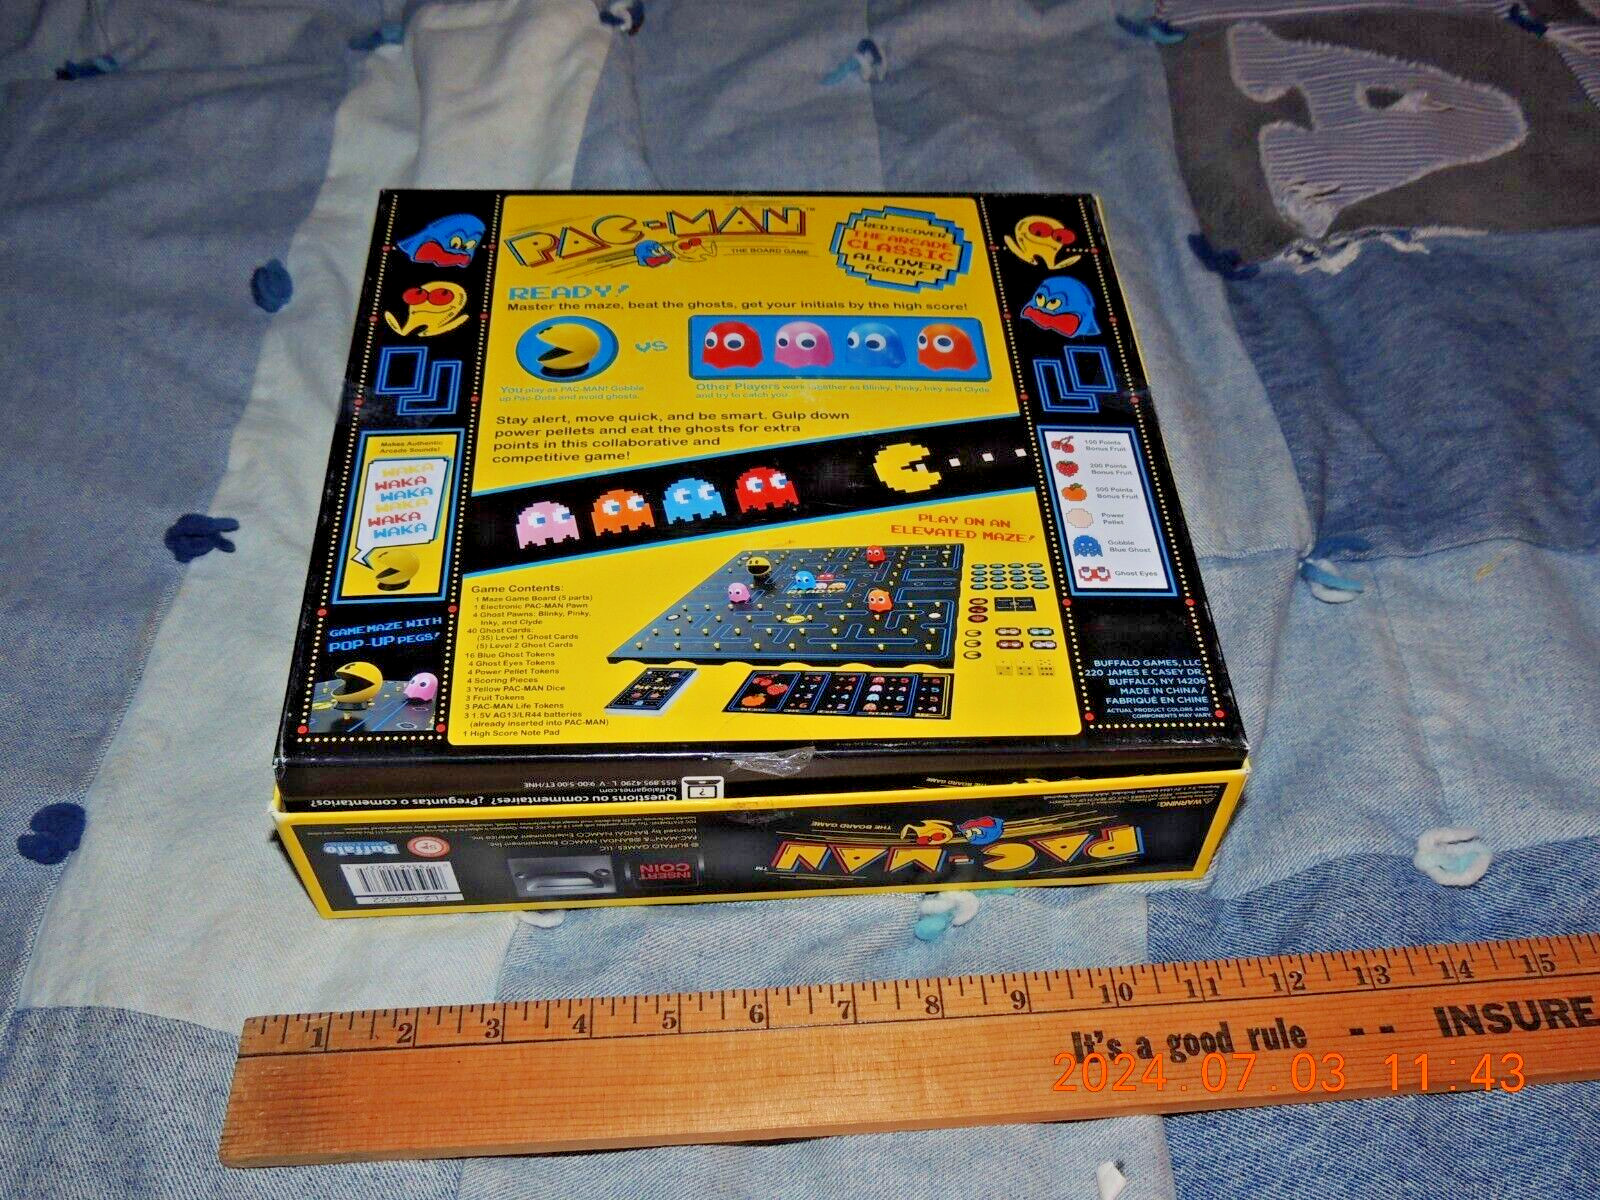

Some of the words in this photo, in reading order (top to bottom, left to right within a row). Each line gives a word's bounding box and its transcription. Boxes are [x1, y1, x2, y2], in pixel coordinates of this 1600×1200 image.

[863, 221, 947, 239] REDISCOVER
[504, 206, 806, 268] PAC-MAN
[851, 230, 885, 244] THE
[888, 235, 951, 250] ARCADE
[731, 247, 748, 255] THE
[783, 248, 810, 256] GAME
[847, 239, 953, 262] CLASSIC
[852, 252, 890, 265] ALL
[894, 257, 943, 272] OVER
[508, 285, 630, 300] READY!
[507, 302, 556, 312] Master
[559, 302, 580, 310] the
[584, 302, 624, 311] maze,
[628, 301, 658, 309] beat
[663, 301, 684, 309] the
[688, 301, 738, 311] ghosts,
[741, 301, 763, 310] get
[767, 301, 796, 310] your
[800, 301, 845, 309] initials
[849, 301, 865, 310] by
[868, 301, 889, 309] the
[893, 301, 922, 311] high
[926, 302, 968, 311] score!
[695, 383, 732, 391] Other
[735, 383, 781, 392] Players
[496, 415, 528, 426] Stay
[533, 414, 570, 424] alert,
[619, 413, 663, 423] quick,
[667, 412, 695, 421] and
[699, 412, 717, 420] be
[721, 411, 767, 420] smart.
[772, 410, 806, 421] Gulp
[811, 411, 850, 420] down
[494, 428, 541, 439] power
[546, 427, 595, 437] pellets
[599, 426, 627, 435] and
[631, 426, 654, 434] eat
[658, 425, 681, 434] the
[685, 424, 735, 436] ghosts
[739, 424, 758, 433] for
[763, 424, 801, 433] extra
[493, 440, 539, 452] points
[544, 440, 557, 449] in
[561, 439, 588, 448] this
[592, 437, 688, 447] collaborative
[693, 437, 720, 446] and
[493, 453, 580, 464] competitive
[584, 451, 631, 462] game!
[375, 475, 427, 491] WAKA
[380, 487, 433, 502] WAKA
[368, 511, 421, 527] WAKA
[918, 514, 958, 524] PLAY
[964, 517, 984, 526] ON
[990, 519, 1010, 528] AN
[374, 523, 427, 539] WAKA
[891, 525, 977, 539] ELEVATED
[982, 532, 1035, 543] MAZE!
[471, 585, 505, 593] Game
[509, 584, 563, 593] Contents:
[329, 625, 366, 637] GAME
[366, 621, 403, 632] MAZE
[406, 617, 442, 627] WITH
[329, 636, 395, 652] POP-UP
[398, 632, 441, 644] PEGS!
[1094, 659, 1140, 667] BUFFALO
[1143, 659, 1181, 667] GAMES,
[1085, 669, 1104, 677] 220
[1108, 678, 1158, 686] BUFFALO,
[1120, 687, 1150, 695] MADE
[472, 702, 513, 710] PAC-MAN
[1160, 696, 1174, 704] EN
[1177, 696, 1209, 704] CHINE
[493, 711, 542, 719] AG13/LR44
[470, 730, 490, 738] High
[599, 786, 677, 794] buffalogames.com
[311, 798, 397, 807] comentarios?
[491, 795, 589, 805] commentaires?
[612, 793, 677, 802] Questions
[1157, 798, 1202, 807] WARNING:
[323, 843, 394, 856] Buffalo
[770, 825, 1144, 873] PAC-MAN
[639, 863, 690, 872] COIN
[639, 871, 691, 881] INSERT
[311, 1027, 325, 1048] 1
[397, 1022, 413, 1044] 2
[485, 1018, 501, 1040] 3
[572, 1013, 588, 1034] 4
[662, 1009, 678, 1030] 5
[749, 1004, 764, 1024] 6
[837, 1000, 851, 1019] 7
[924, 995, 940, 1014] 8
[1010, 990, 1026, 1009] 9
[1099, 982, 1133, 1004] 10
[1184, 977, 1221, 998] 11
[1269, 971, 1306, 992] 12
[1352, 964, 1391, 987] 13
[1437, 960, 1475, 980] 14
[1518, 954, 1556, 973] 15
[1433, 995, 1600, 1038] INSURE
[1071, 1031, 1122, 1063] It's
[1136, 1035, 1154, 1060] a
[1166, 1021, 1235, 1063] good
[1246, 1017, 1309, 1051] rule
